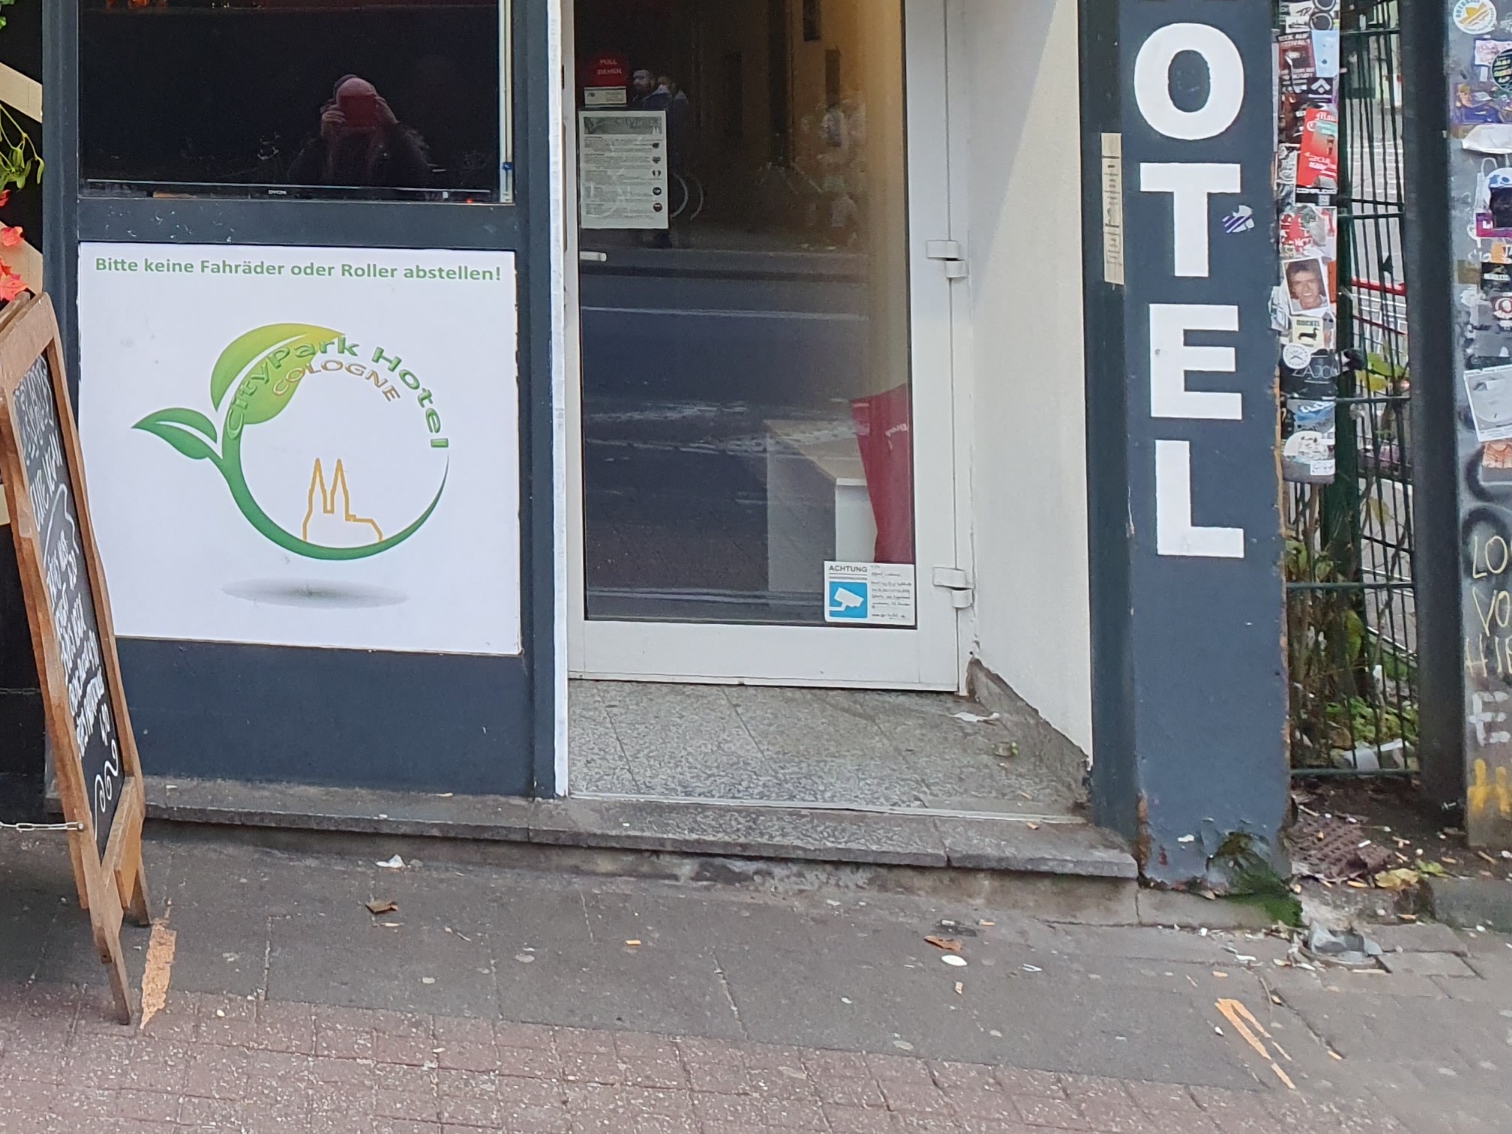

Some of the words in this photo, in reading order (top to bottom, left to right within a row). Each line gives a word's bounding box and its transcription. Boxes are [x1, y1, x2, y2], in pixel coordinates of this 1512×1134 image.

[95, 257, 138, 272] Bitte
[143, 258, 195, 274] keine
[200, 259, 285, 276] Fahräder
[290, 262, 335, 278] oder
[341, 263, 398, 279] Roller
[403, 264, 502, 282] abstellen!
[226, 335, 360, 441] CityPark
[372, 346, 449, 449] Hotel
[272, 358, 401, 403] COLOGNE
